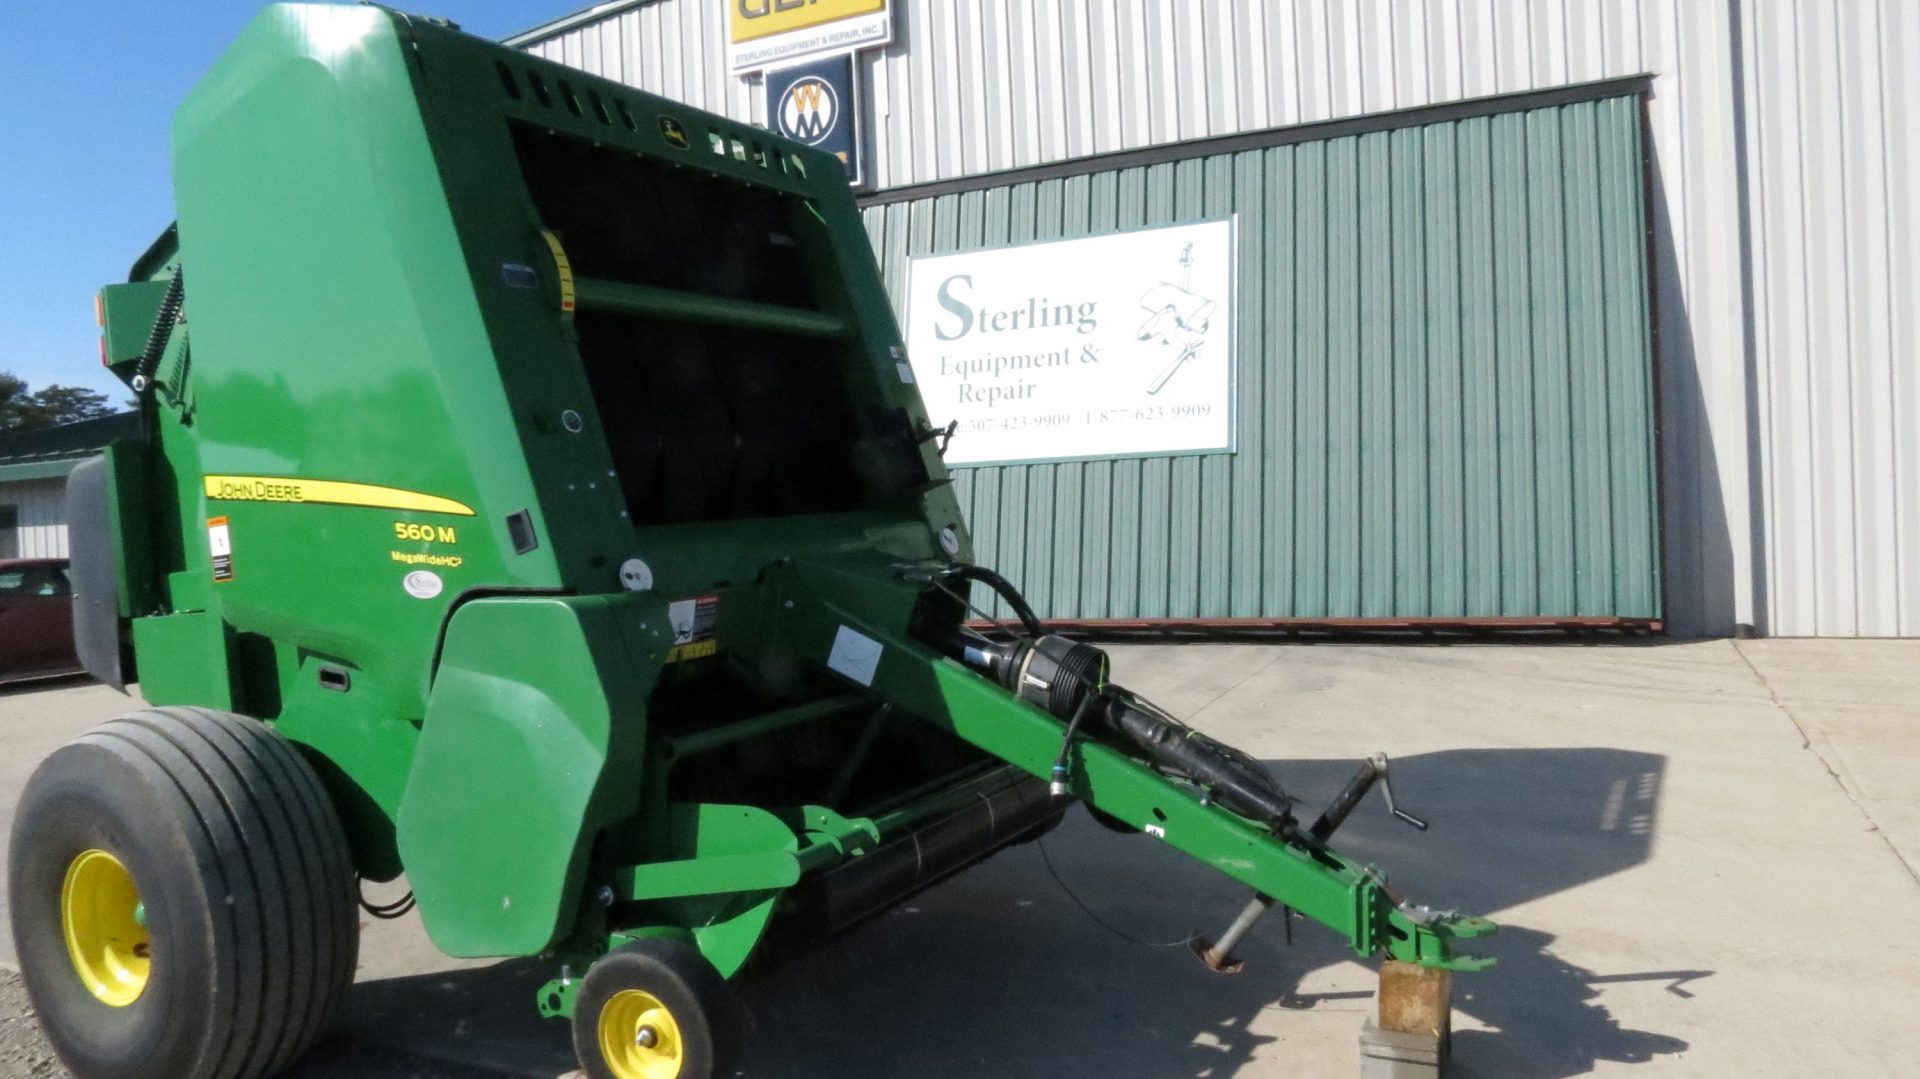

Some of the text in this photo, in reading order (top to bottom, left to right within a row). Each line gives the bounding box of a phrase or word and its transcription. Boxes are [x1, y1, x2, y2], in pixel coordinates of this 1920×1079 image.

[735, 24, 880, 63] STERLING EQUIPMENT & REPAIR, INC.
[934, 274, 1098, 341] Sterling
[940, 342, 1099, 380] Equipment &
[958, 378, 1037, 407] Repair
[1085, 403, 1212, 425] 1-877-623-9909
[217, 481, 302, 500] JOHN DEERE
[394, 522, 456, 544] 560 M
